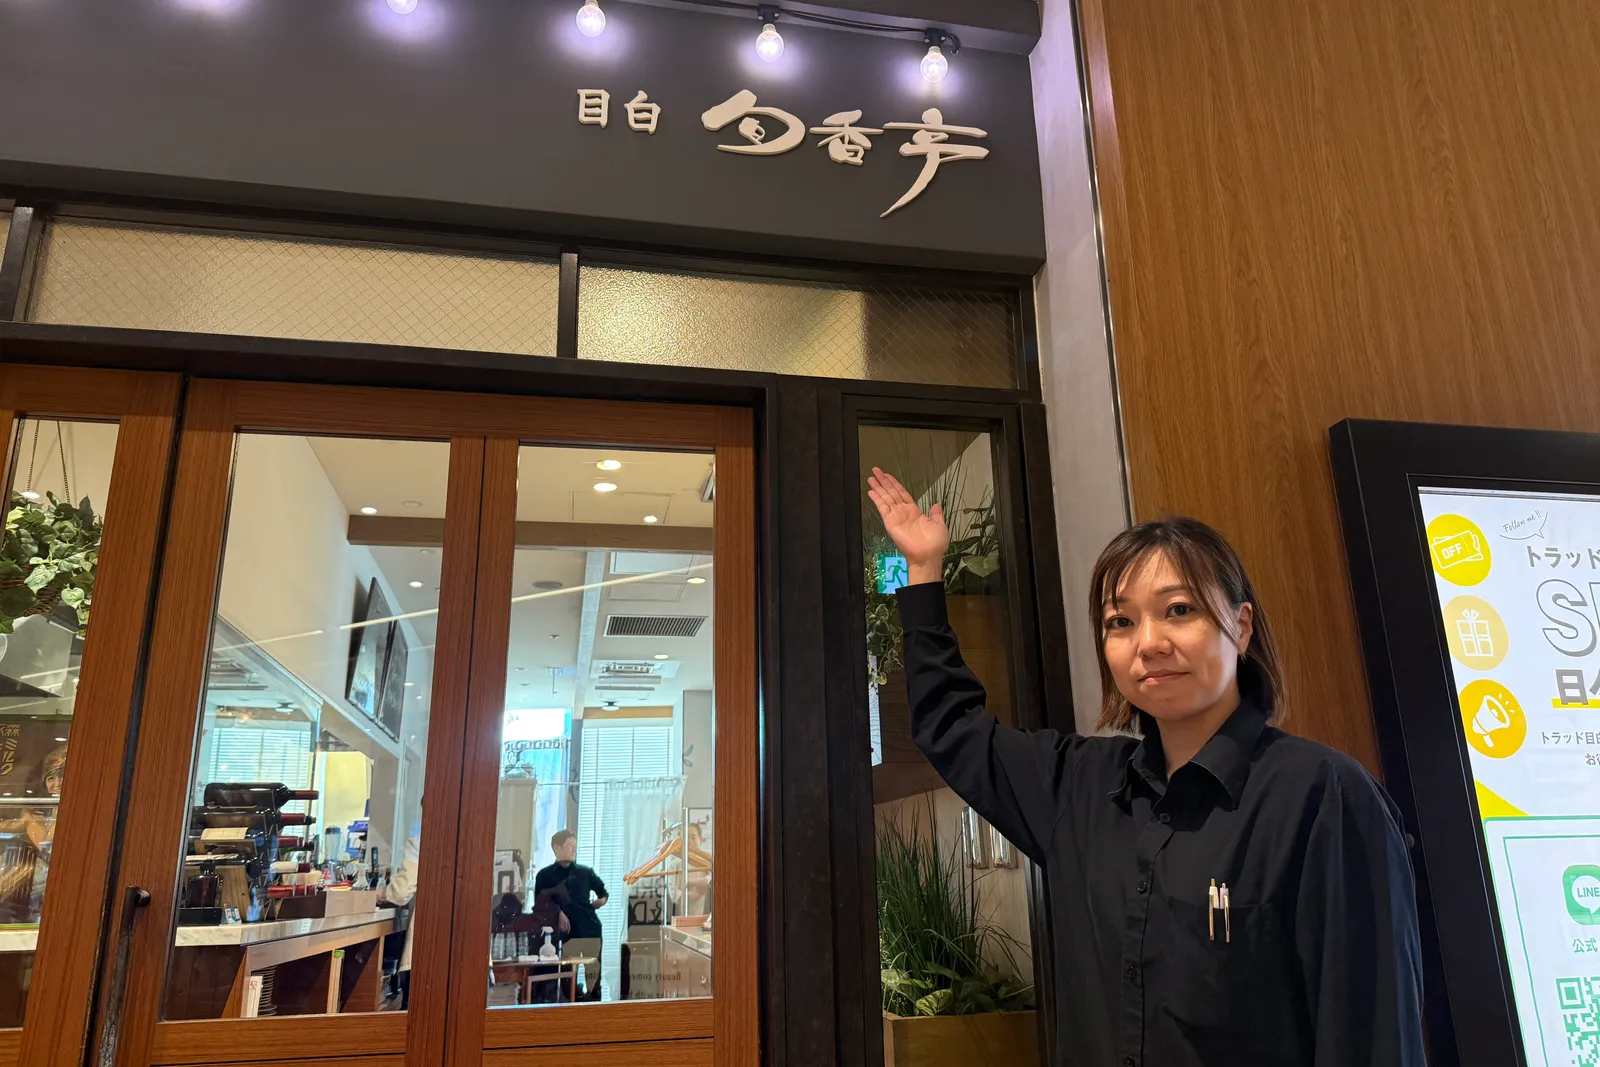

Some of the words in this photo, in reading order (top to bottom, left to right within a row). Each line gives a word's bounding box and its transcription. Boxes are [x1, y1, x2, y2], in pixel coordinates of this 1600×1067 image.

[576, 88, 661, 134] 目白
[701, 89, 990, 218] 旬香亭
[1502, 520, 1526, 533] Follow
[1441, 543, 1463, 560] OFF
[1536, 579, 1600, 657] S
[1555, 668, 1600, 705] 日
[1577, 886, 1600, 898] LINE
[1572, 937, 1598, 954] 公式
